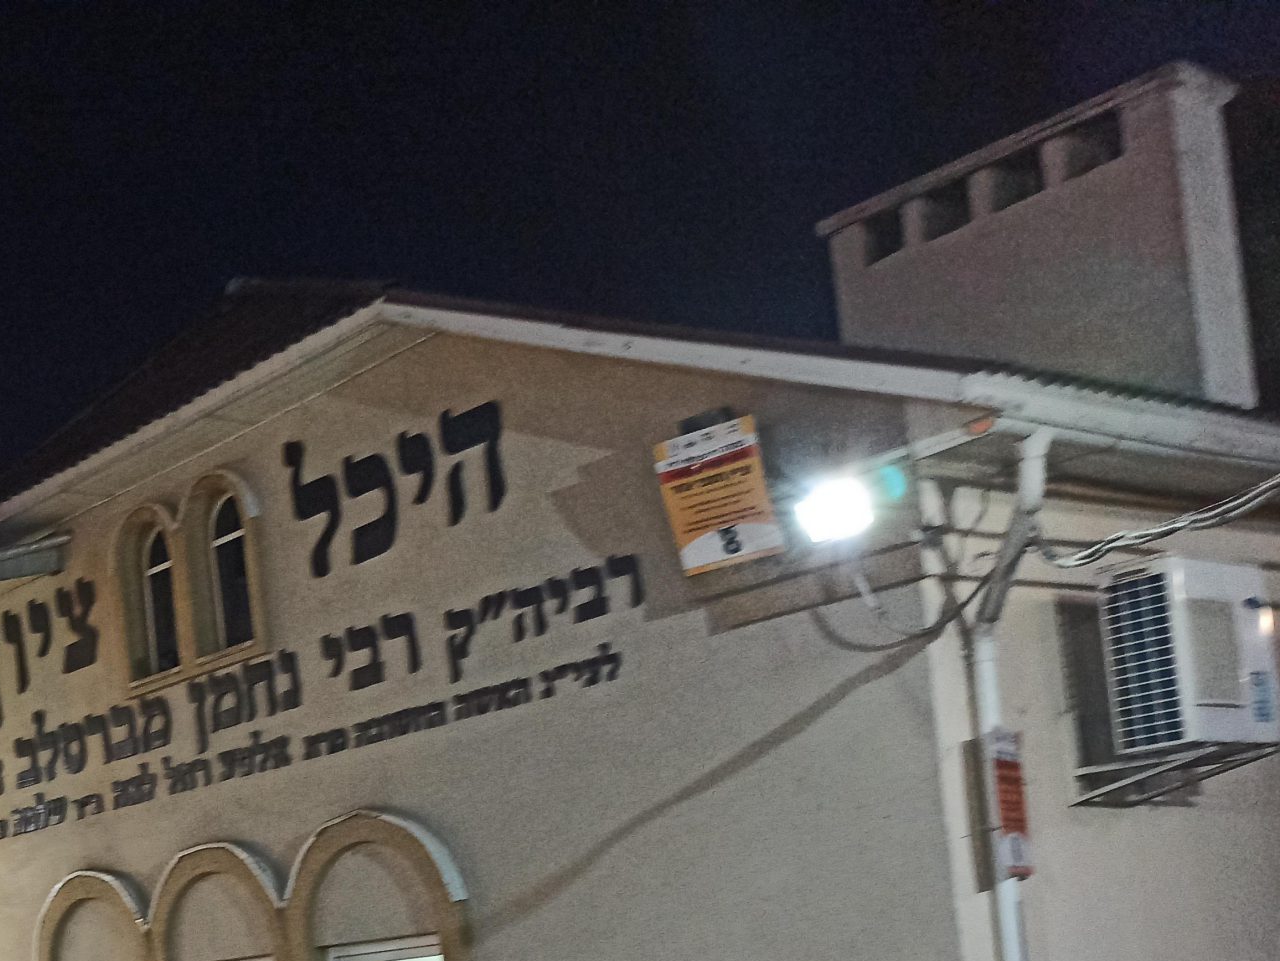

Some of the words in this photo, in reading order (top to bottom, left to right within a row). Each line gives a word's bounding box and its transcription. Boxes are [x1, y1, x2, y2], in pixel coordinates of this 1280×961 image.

[282, 400, 508, 578] היכל
[321, 612, 421, 691] רבי
[13, 696, 172, 789] מברסלב
[188, 649, 302, 753] נחמן
